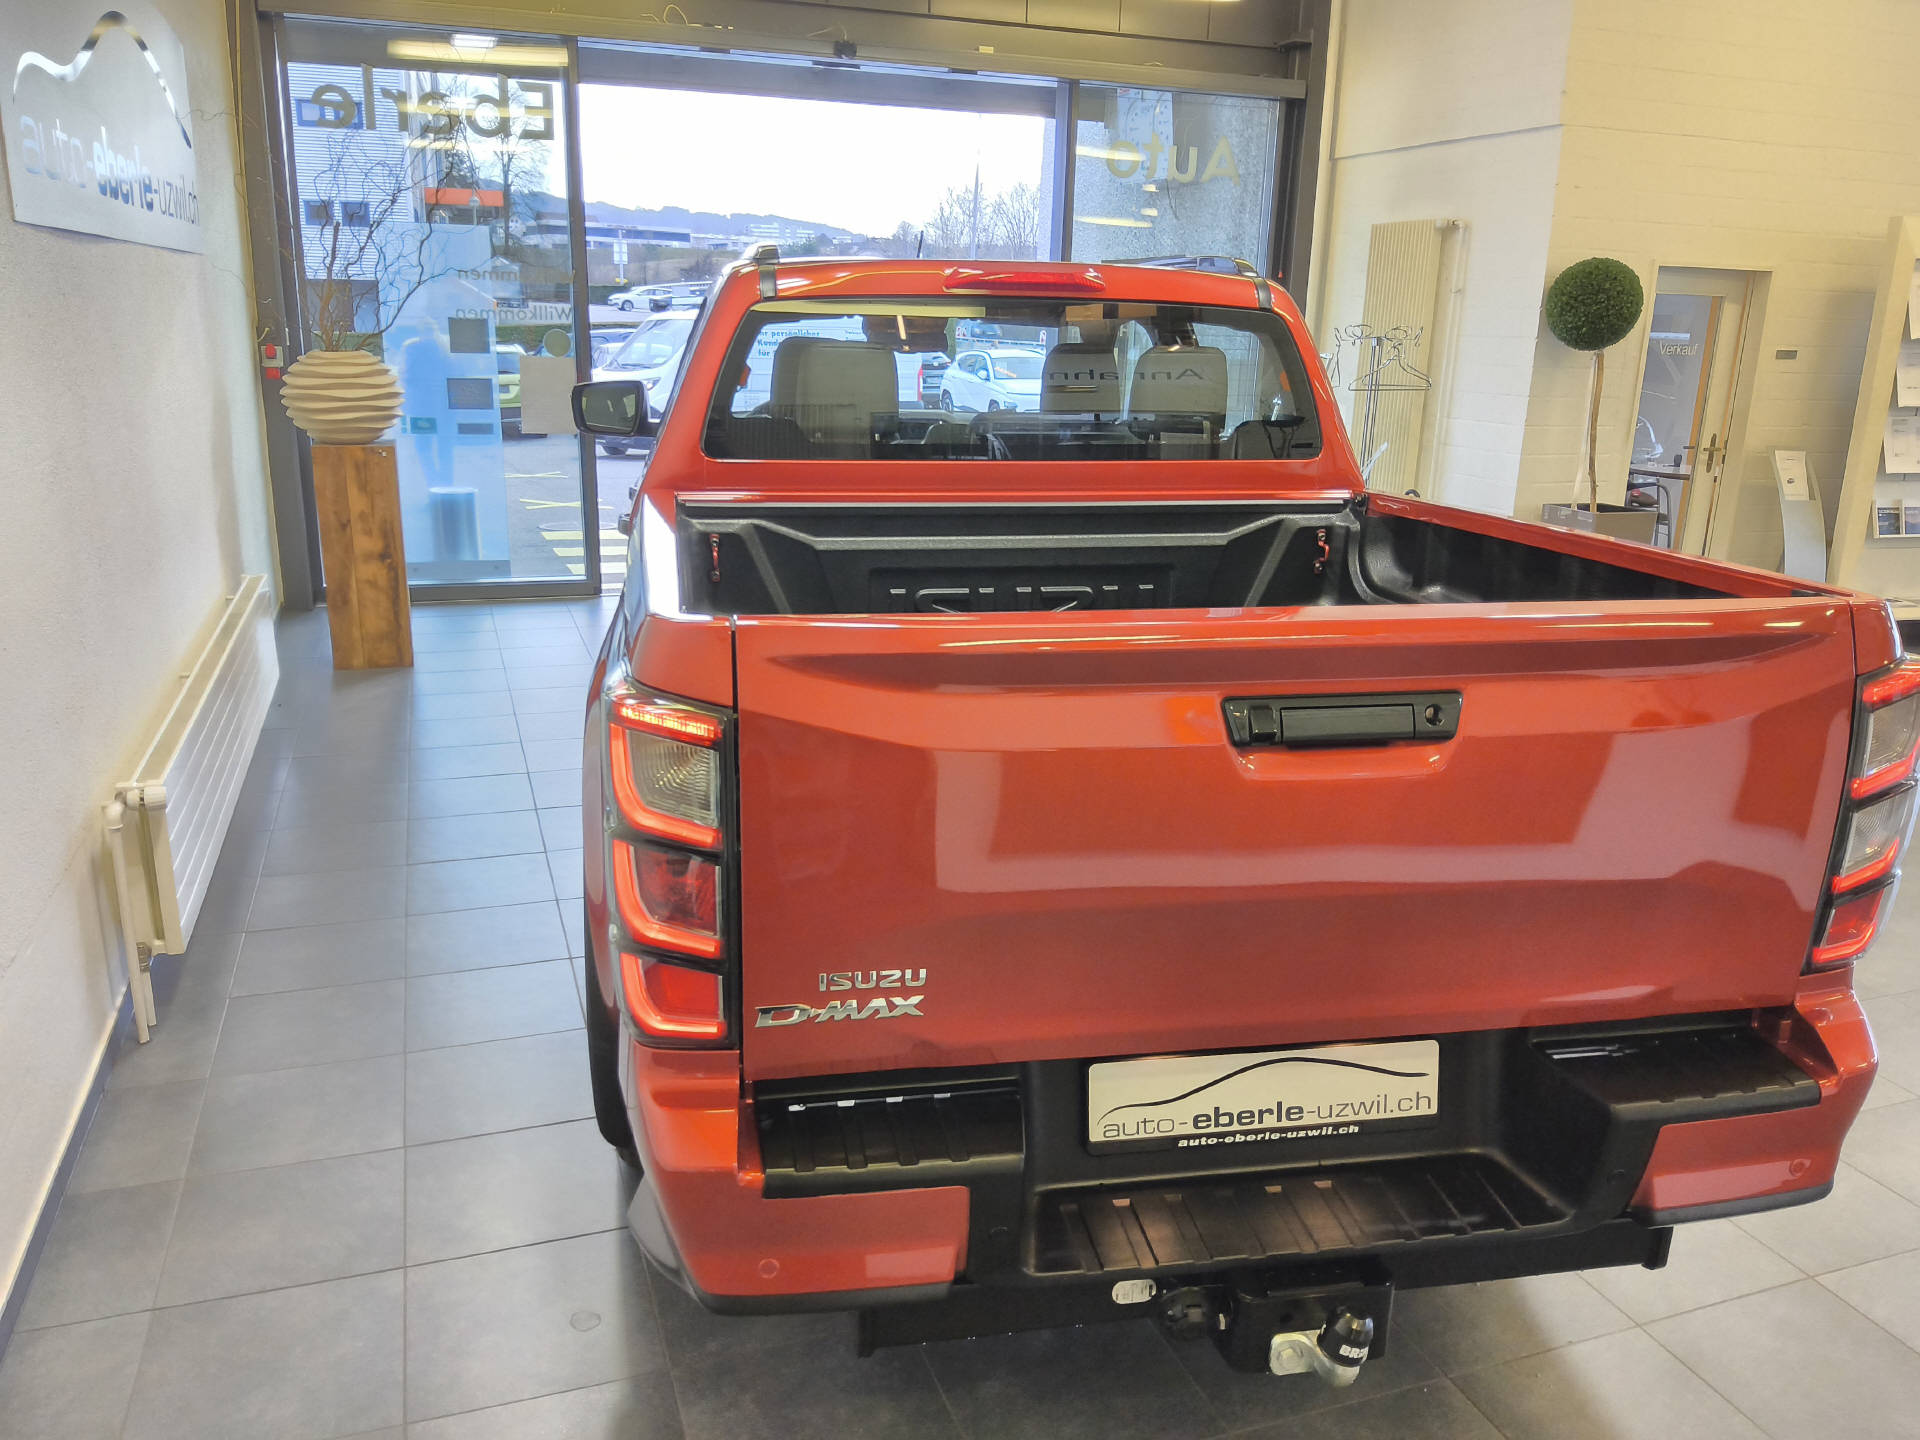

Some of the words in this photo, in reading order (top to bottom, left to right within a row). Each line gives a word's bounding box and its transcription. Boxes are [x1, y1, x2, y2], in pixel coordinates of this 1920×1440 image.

[1659, 341, 1698, 355] Verkauf
[819, 968, 927, 992] ISUZU
[754, 995, 925, 1028] D-MAX
[1102, 1091, 1432, 1138] auto-eberle-uzwil.ch
[1178, 1124, 1359, 1147] auto-eberle-uzwil.ch
